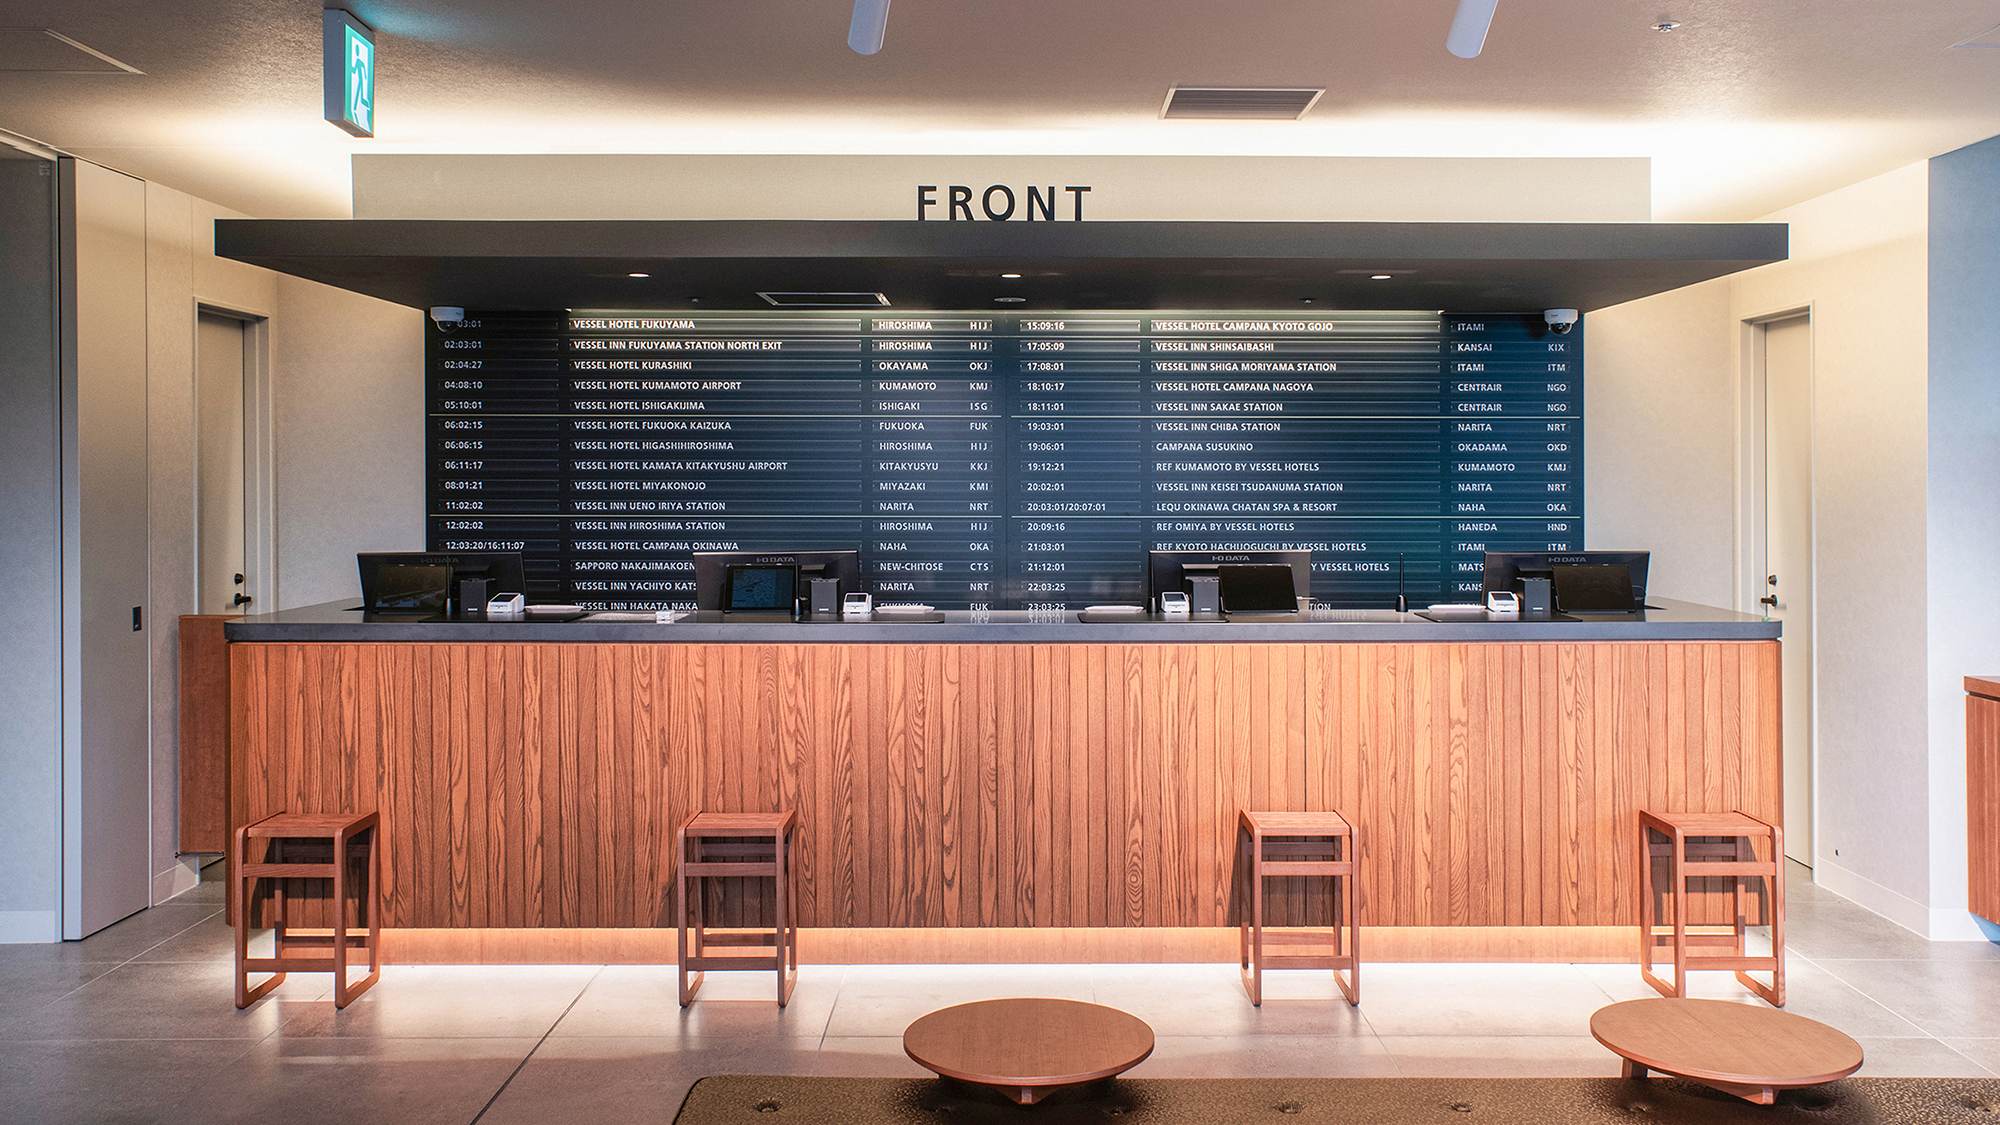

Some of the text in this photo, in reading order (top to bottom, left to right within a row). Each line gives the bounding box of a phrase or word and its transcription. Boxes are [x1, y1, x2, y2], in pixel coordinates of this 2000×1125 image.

[917, 184, 1092, 221] FRONT
[573, 320, 696, 330] VESSEL HOTEL FUKUYAMA
[878, 320, 933, 330] HIROSHIMA
[1026, 321, 1065, 331] 15:09:16
[1155, 322, 1334, 332] VESSEL HOTEL CAMPANA KYOTO GOJO
[1457, 323, 1485, 331] ITAMI
[444, 340, 482, 349] 02:03:01
[573, 340, 783, 350] VESSEL INN FUKUYAMA STATION NORTH EXIT
[878, 341, 933, 351] HIROSHIMA
[1026, 342, 1065, 351] 17:05:09
[1155, 342, 1274, 351] VESSEL INN SHINSAIBASHI
[1457, 343, 1493, 352] KANSAI
[1548, 343, 1565, 352] KIX
[444, 360, 483, 369] 02:04:27
[573, 361, 692, 370] VESSEL HOTEL KURASHIKI
[878, 361, 929, 371] OKAYAMA
[969, 362, 988, 371] OKJ
[1027, 362, 1064, 371] 17:08:01
[1155, 362, 1337, 372] VESSEL INN SHIGA MORIYAMA STATION
[1457, 363, 1485, 372] ITAMI
[444, 380, 483, 389] 04:08:10
[574, 381, 742, 390] VESSEL HOTEL KUMAMOTO AIRPORT
[879, 382, 937, 391] KUMAMOTO
[1027, 382, 1065, 391] 18:10:17
[1155, 382, 1314, 392] VESSEL HOTEL CAMPANA NAGOYA
[1457, 383, 1502, 392] CENTRAIR
[444, 400, 482, 410] 05:10:01
[574, 401, 706, 410] VESSEL HOTEL ISHIGAKIJIMA
[879, 402, 920, 411] ISHIGAKI
[1027, 402, 1064, 411] 18:11:01
[1155, 402, 1283, 412] VESSEL INN SAKAE STATION
[1457, 403, 1503, 412] CENTRAIR
[444, 420, 483, 429] 06:02:15
[574, 421, 732, 430] VESSEL HOTEL FUKUOKA KAIZUKA
[879, 422, 925, 431] FUKUOKA
[1027, 422, 1064, 431] 19:03:01
[1155, 422, 1281, 431] VESSEL INN CHIBA STATION
[1457, 423, 1493, 432] NARITA
[444, 440, 483, 450] 06:06:15
[574, 441, 734, 450] VESSEL HOTEL HIGASHIHIROSHIMA
[879, 442, 933, 451] HIROSHIMA
[1027, 442, 1064, 451] 19:06:01
[1155, 442, 1254, 452] CAMPANA SUSUKINO
[1457, 443, 1508, 452] OKADAMA
[1546, 443, 1568, 452] OKD
[444, 460, 483, 470] 06:11:17
[574, 461, 788, 470] VESSEL HOTEL KAMATA KITAKYUSHU AIRPORT
[879, 462, 939, 471] KITAKYUSYU
[1027, 462, 1065, 471] 19:12:21
[1156, 462, 1320, 472] REF KUMAMOTO BY VESSEL HOTELS
[1458, 463, 1516, 472] KUMAMOTO
[444, 481, 483, 490] 08:01:21
[574, 481, 707, 490] VESSEL HOTEL MIYAKONOJO
[879, 482, 926, 491] MIYAZAKI
[1027, 482, 1065, 491] 20:02:01
[1155, 482, 1343, 492] VESSEL INN KEISEI TSUDANUMA STATION
[1458, 483, 1493, 492] NARITA
[445, 501, 483, 510] 11:02:02
[574, 501, 726, 511] VESSEL INN UENO IRIYA STATION
[879, 502, 915, 511] NARITA
[969, 502, 989, 511] NRT
[1027, 502, 1106, 511] 20:03:01/20:07:01
[1156, 502, 1181, 512] LEQU
[1183, 503, 1230, 511] OKINAWA
[1231, 503, 1271, 511] CHATAN
[1272, 503, 1291, 512] SPA
[1302, 503, 1338, 512] RESORT
[1458, 503, 1486, 512] NAHA
[445, 521, 484, 530] 12:02:02
[574, 521, 726, 530] VESSEL INN HIROSHIMA STATION
[879, 522, 934, 531] HIROSHIMA
[1027, 522, 1066, 531] 20:09:16
[1156, 522, 1295, 531] REF OMIYA BY VESSEL HOTELS
[1458, 523, 1498, 531] HANEDA
[445, 541, 525, 550] 12:03:20/16:11:07
[574, 541, 739, 551] VESSEL HOTEL CAMPANA OKINAWA
[879, 542, 908, 551] NAHA
[1027, 542, 1065, 551] 21:03:01
[880, 562, 944, 571] NEW-CHITOSE
[1027, 562, 1065, 571] 21:12:01
[880, 582, 915, 591] NARITA
[1027, 582, 1066, 592] 22:03:25
